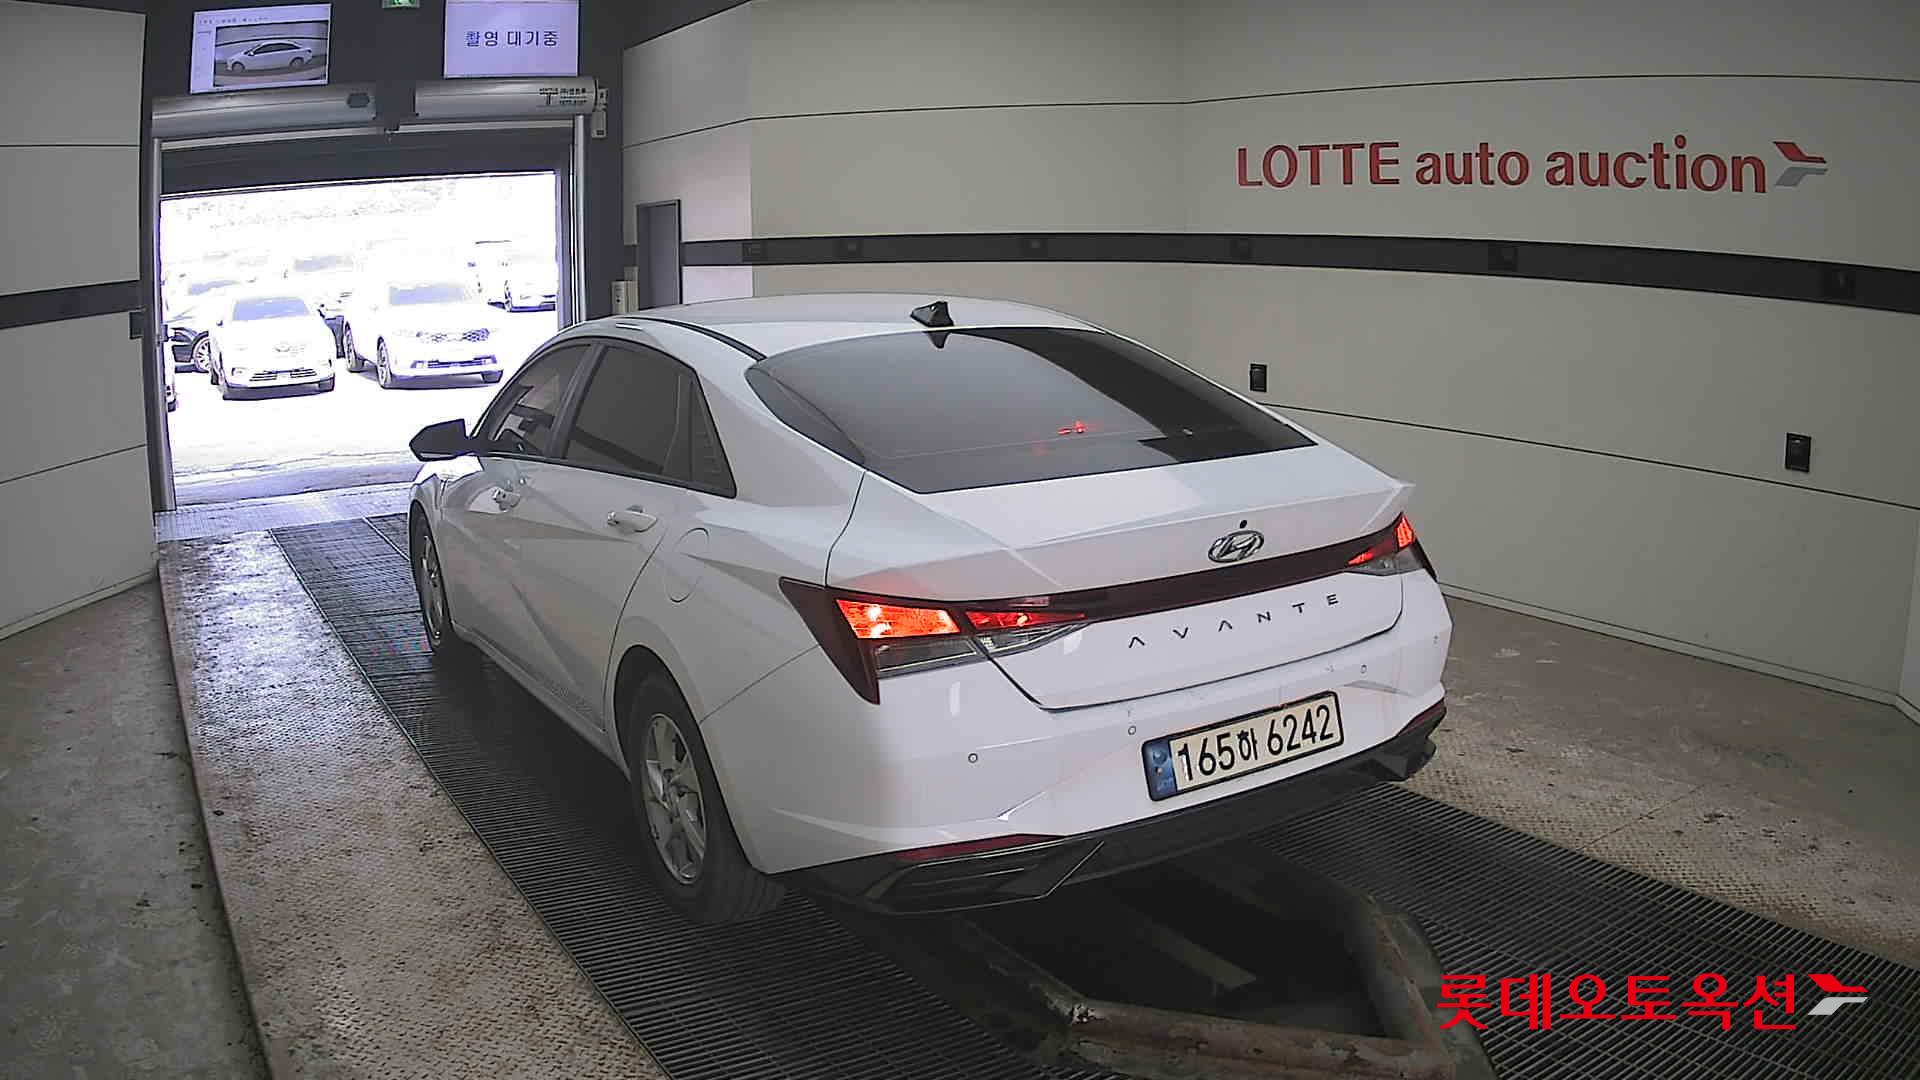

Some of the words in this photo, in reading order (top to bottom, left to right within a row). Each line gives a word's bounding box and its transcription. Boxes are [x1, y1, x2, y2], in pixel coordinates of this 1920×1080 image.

[465, 30, 498, 47] 촬영
[507, 30, 558, 47] 대기중
[1238, 141, 1400, 188] LOTTE
[1415, 142, 1530, 186] auto
[1545, 134, 1767, 194] auction
[1128, 593, 1339, 649] AVANTE
[1176, 727, 1259, 782] 165하
[1266, 703, 1335, 756] 6242
